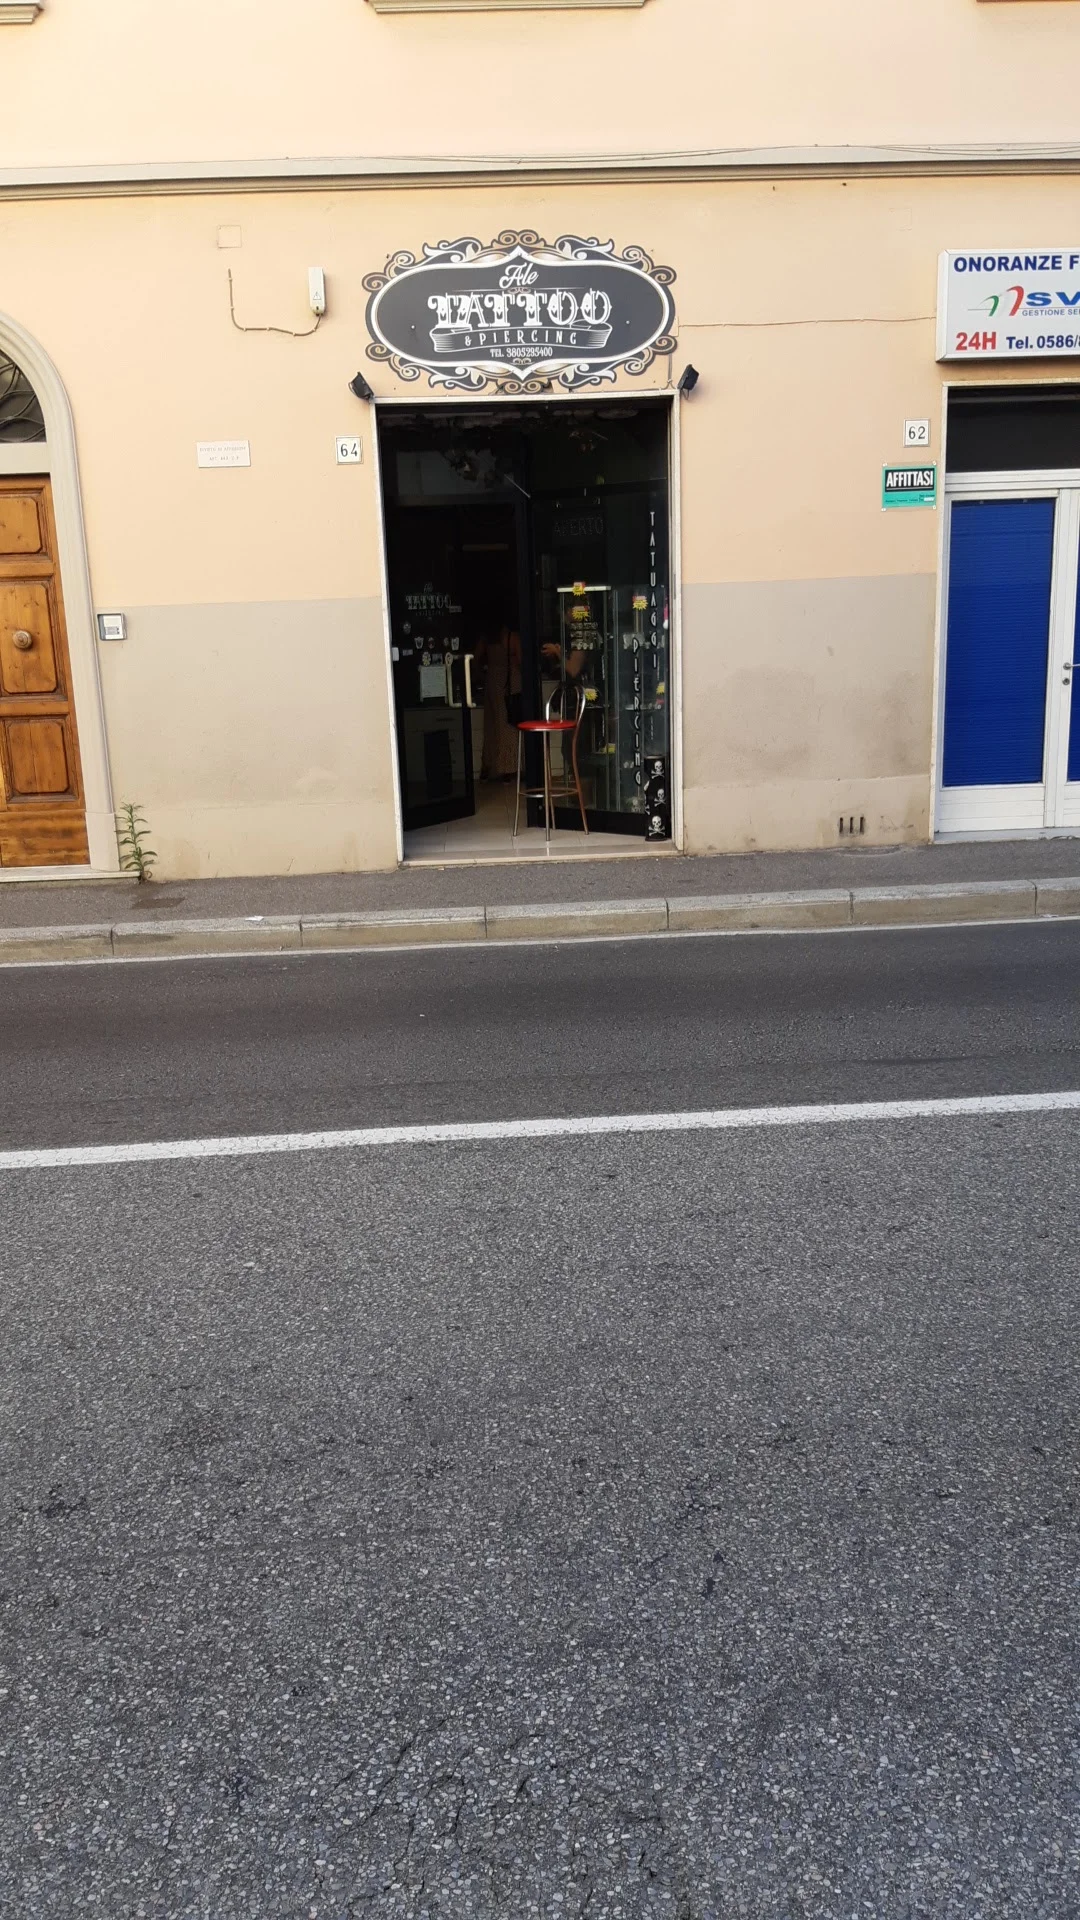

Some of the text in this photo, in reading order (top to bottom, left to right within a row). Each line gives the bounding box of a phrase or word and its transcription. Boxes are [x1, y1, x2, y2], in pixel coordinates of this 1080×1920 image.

[953, 255, 1062, 272] ONORANZE
[498, 262, 539, 289] Ale
[427, 288, 612, 329] TATTOO
[1022, 309, 1065, 317] GESTIONE
[464, 329, 577, 347] & PIERCING
[955, 331, 997, 351] 24H
[1006, 336, 1033, 350] Tel.
[489, 348, 505, 358] TEL.
[908, 425, 926, 440] 62
[340, 443, 358, 458] 64
[886, 470, 934, 488] AFFITTASI
[649, 511, 658, 669] TATUAGGI
[632, 637, 642, 786] PIERCING
